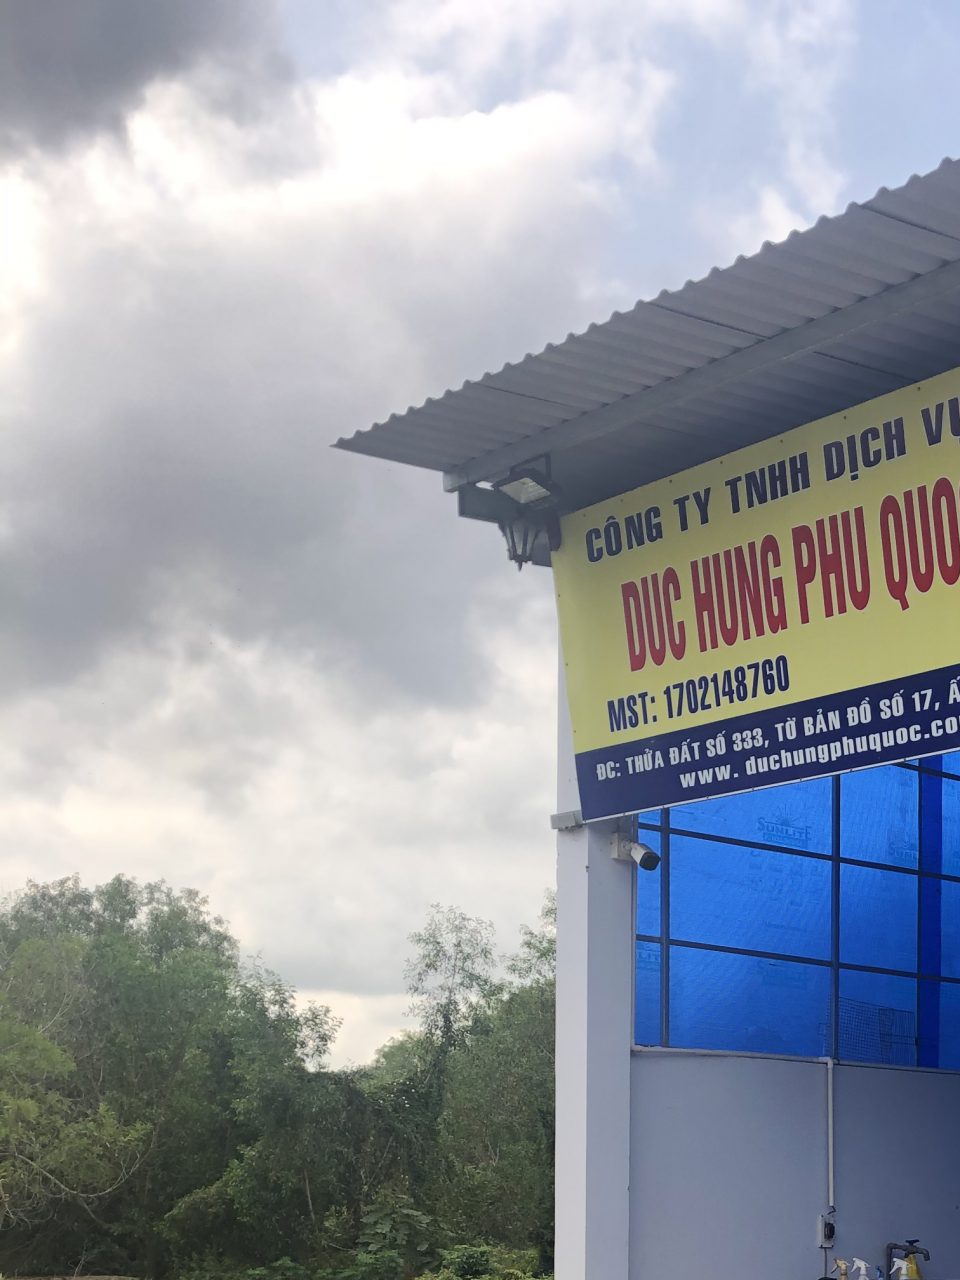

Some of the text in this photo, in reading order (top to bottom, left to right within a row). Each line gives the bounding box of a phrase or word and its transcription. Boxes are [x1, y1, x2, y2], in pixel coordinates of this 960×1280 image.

[586, 507, 663, 563] CÔNG
[674, 487, 710, 531] TY
[725, 452, 810, 514] TNHH
[823, 416, 907, 481] DỊCH
[621, 566, 687, 672] DUC
[690, 534, 788, 653] HUNG
[791, 505, 871, 624] PHU
[597, 762, 621, 781] ĐC:
[625, 746, 664, 774] THỬA
[669, 736, 701, 765] ĐẤT
[706, 729, 726, 754] SỐ
[732, 727, 769, 752] 333,
[775, 715, 797, 742] TỜ
[803, 708, 840, 735] BẢN
[847, 693, 872, 725] ĐỒ
[879, 690, 904, 719] SỐ
[911, 687, 940, 712] 17,
[607, 655, 790, 732] MST: 1702148760
[679, 764, 739, 788] www.
